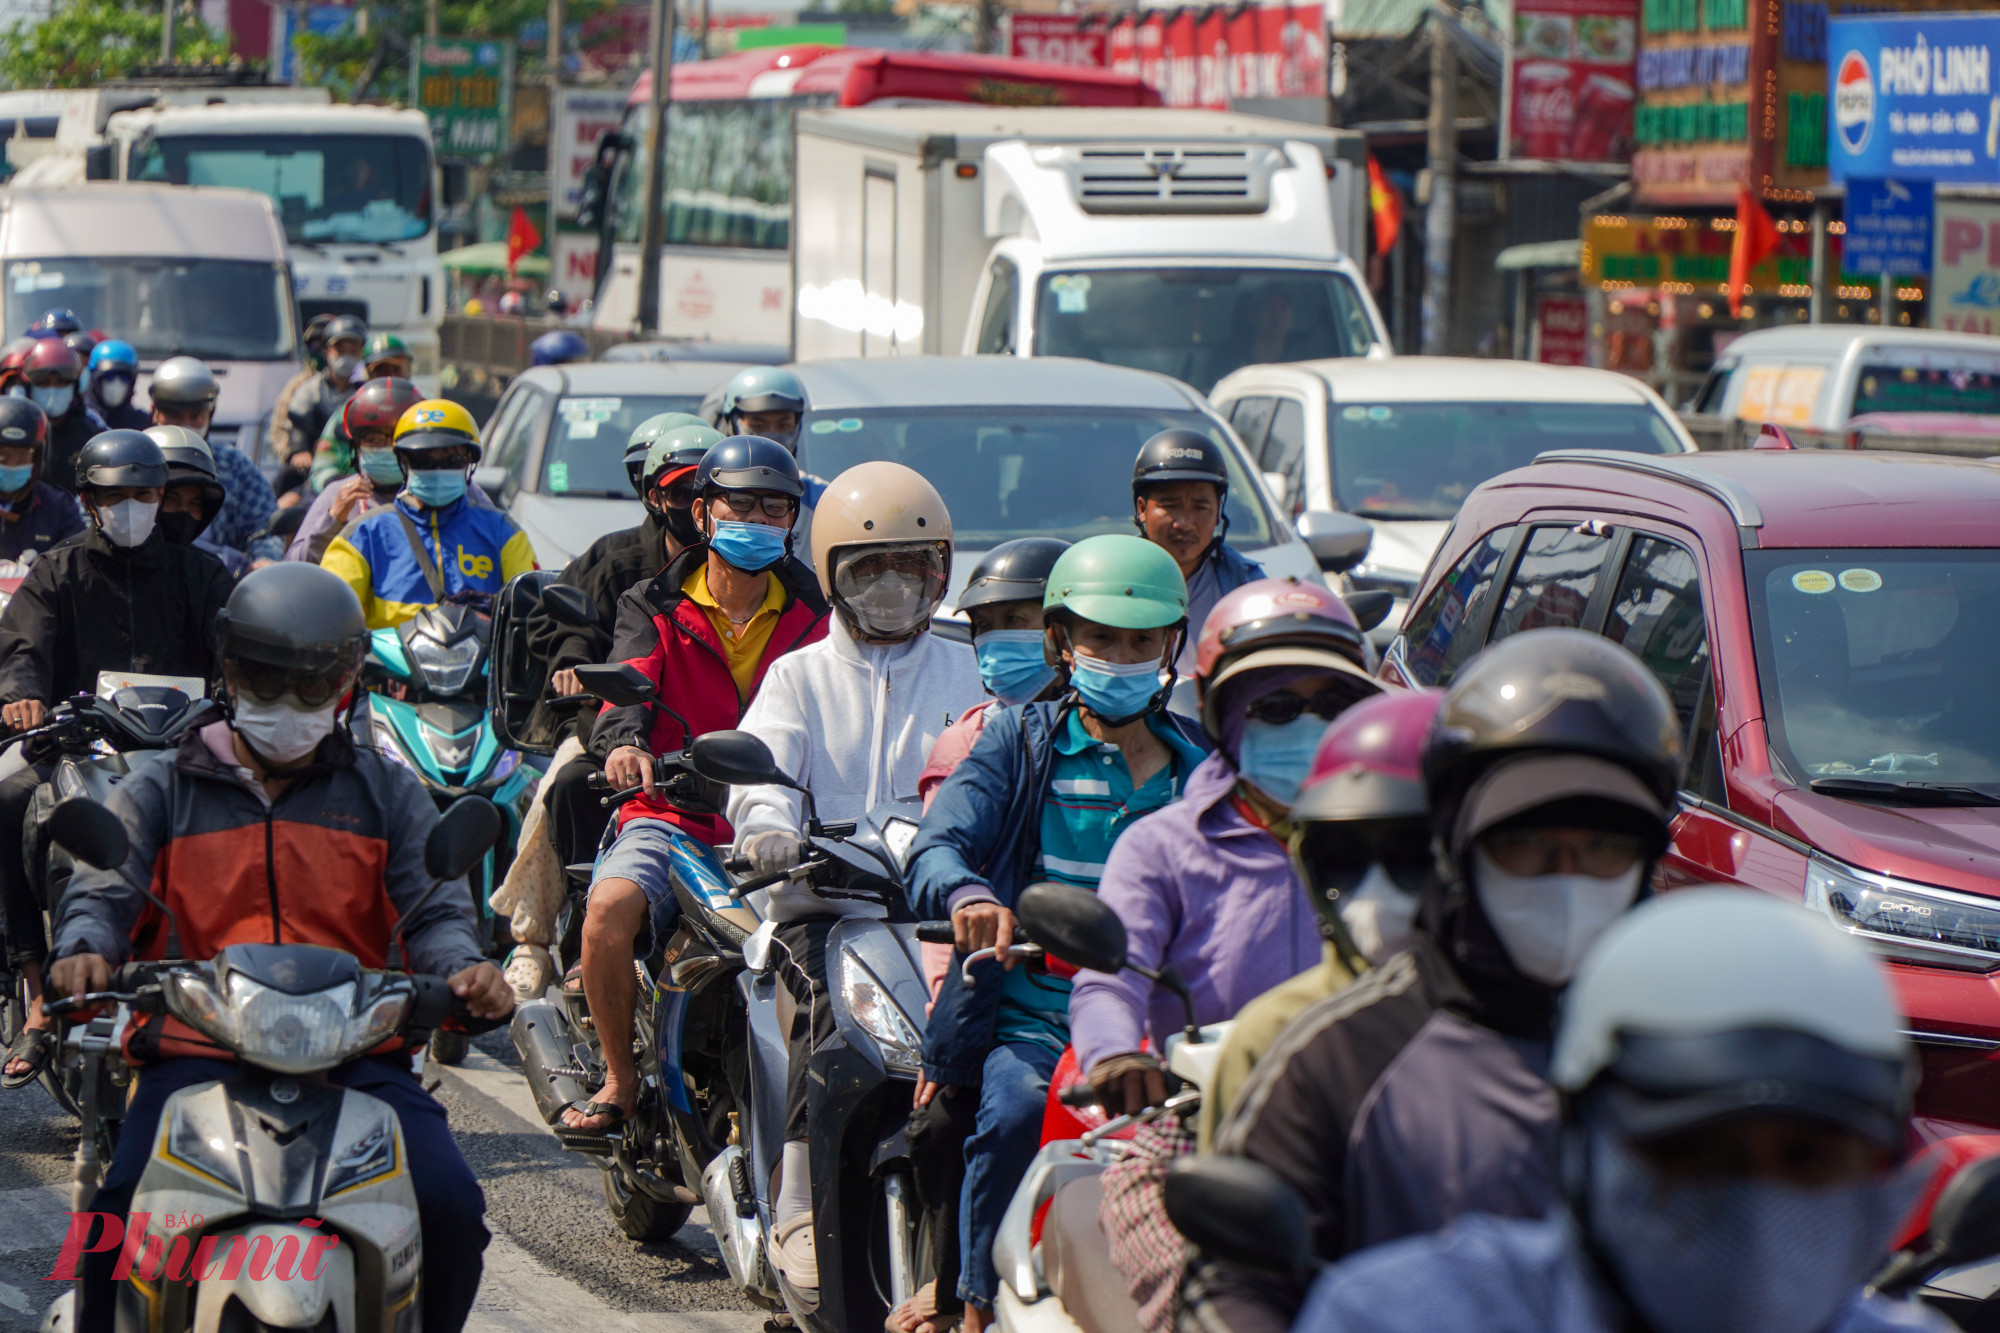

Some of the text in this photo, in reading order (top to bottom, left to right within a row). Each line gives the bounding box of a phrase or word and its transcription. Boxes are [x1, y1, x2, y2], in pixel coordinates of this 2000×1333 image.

[1933, 44, 1990, 96] LINH
[416, 408, 445, 423] be
[457, 544, 494, 579] be
